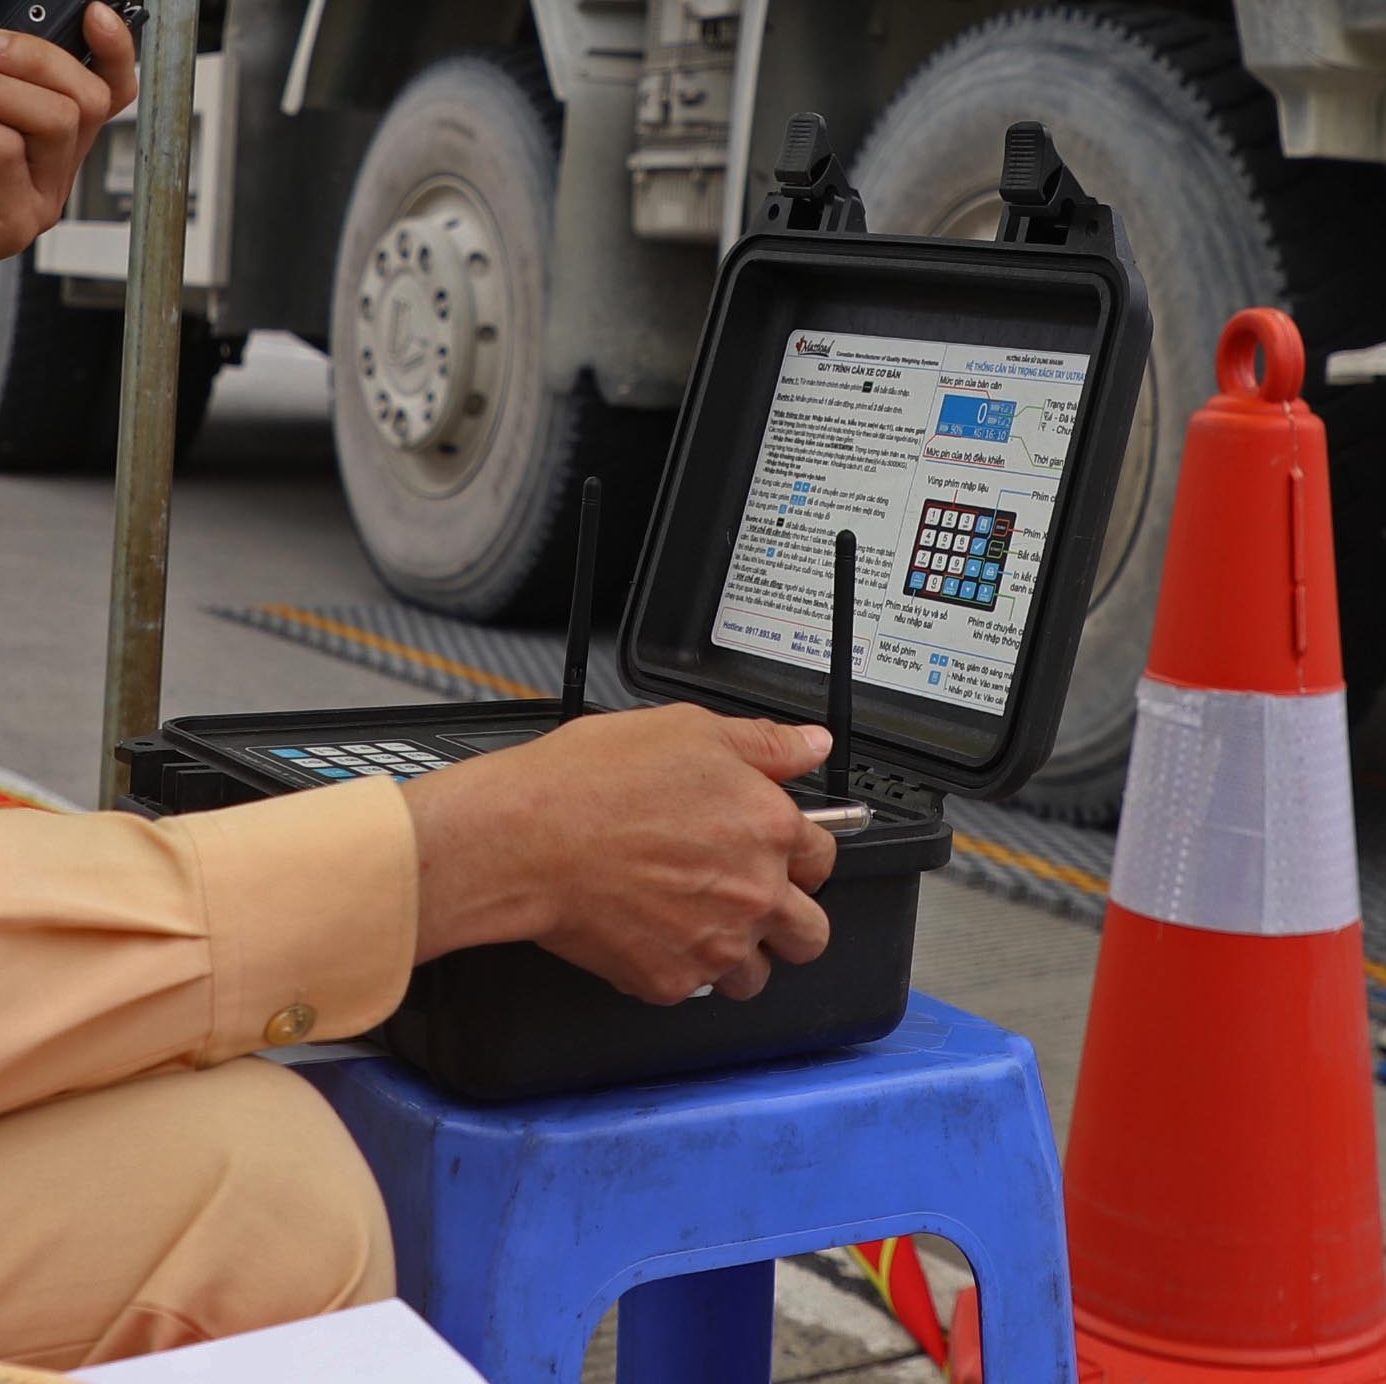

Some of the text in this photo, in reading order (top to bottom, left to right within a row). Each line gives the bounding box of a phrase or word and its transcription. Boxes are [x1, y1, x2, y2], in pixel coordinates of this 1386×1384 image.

[948, 513, 953, 521] 2
[964, 515, 970, 524] 3
[943, 534, 948, 542] 5
[959, 537, 965, 545] 6
[921, 553, 960, 567] 7 8 9
